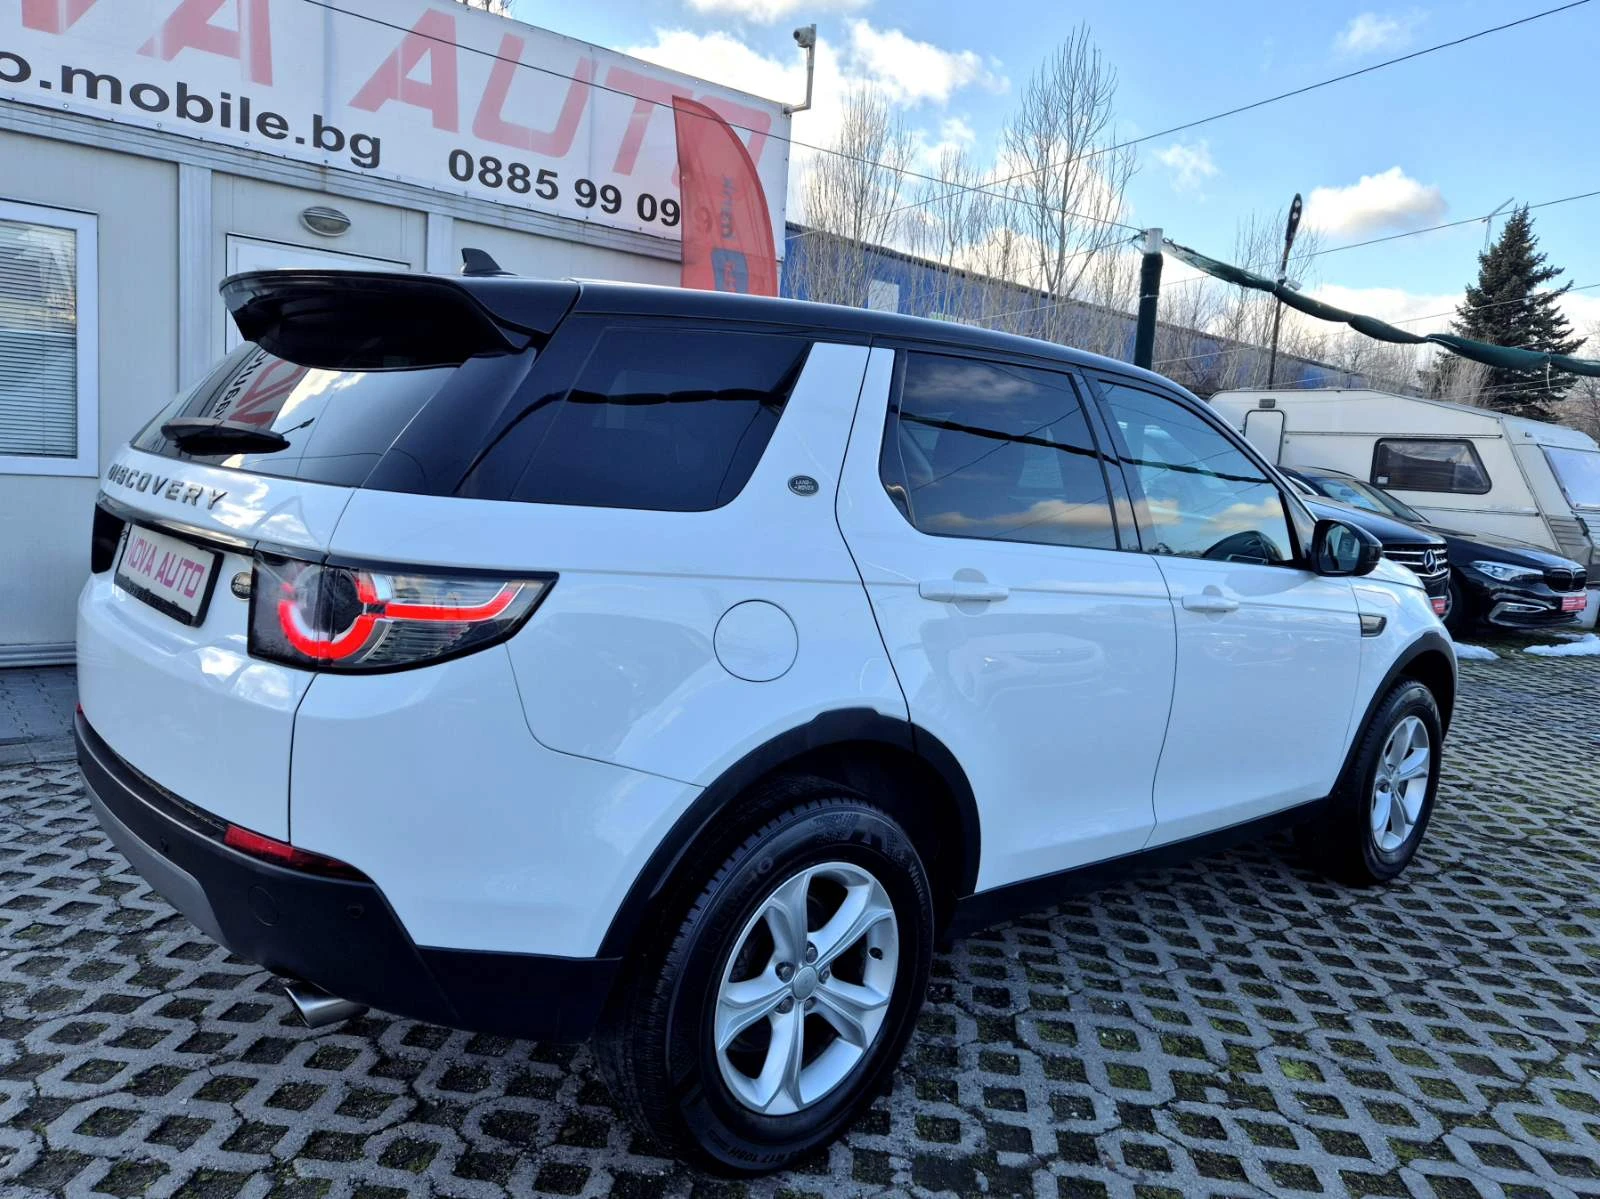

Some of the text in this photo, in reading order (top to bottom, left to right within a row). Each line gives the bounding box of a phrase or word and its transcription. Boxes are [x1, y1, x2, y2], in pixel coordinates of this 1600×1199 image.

[448, 149, 560, 201] 0885
[574, 178, 622, 215] 99
[637, 193, 681, 227] 09
[154, 551, 206, 599] AUTO
